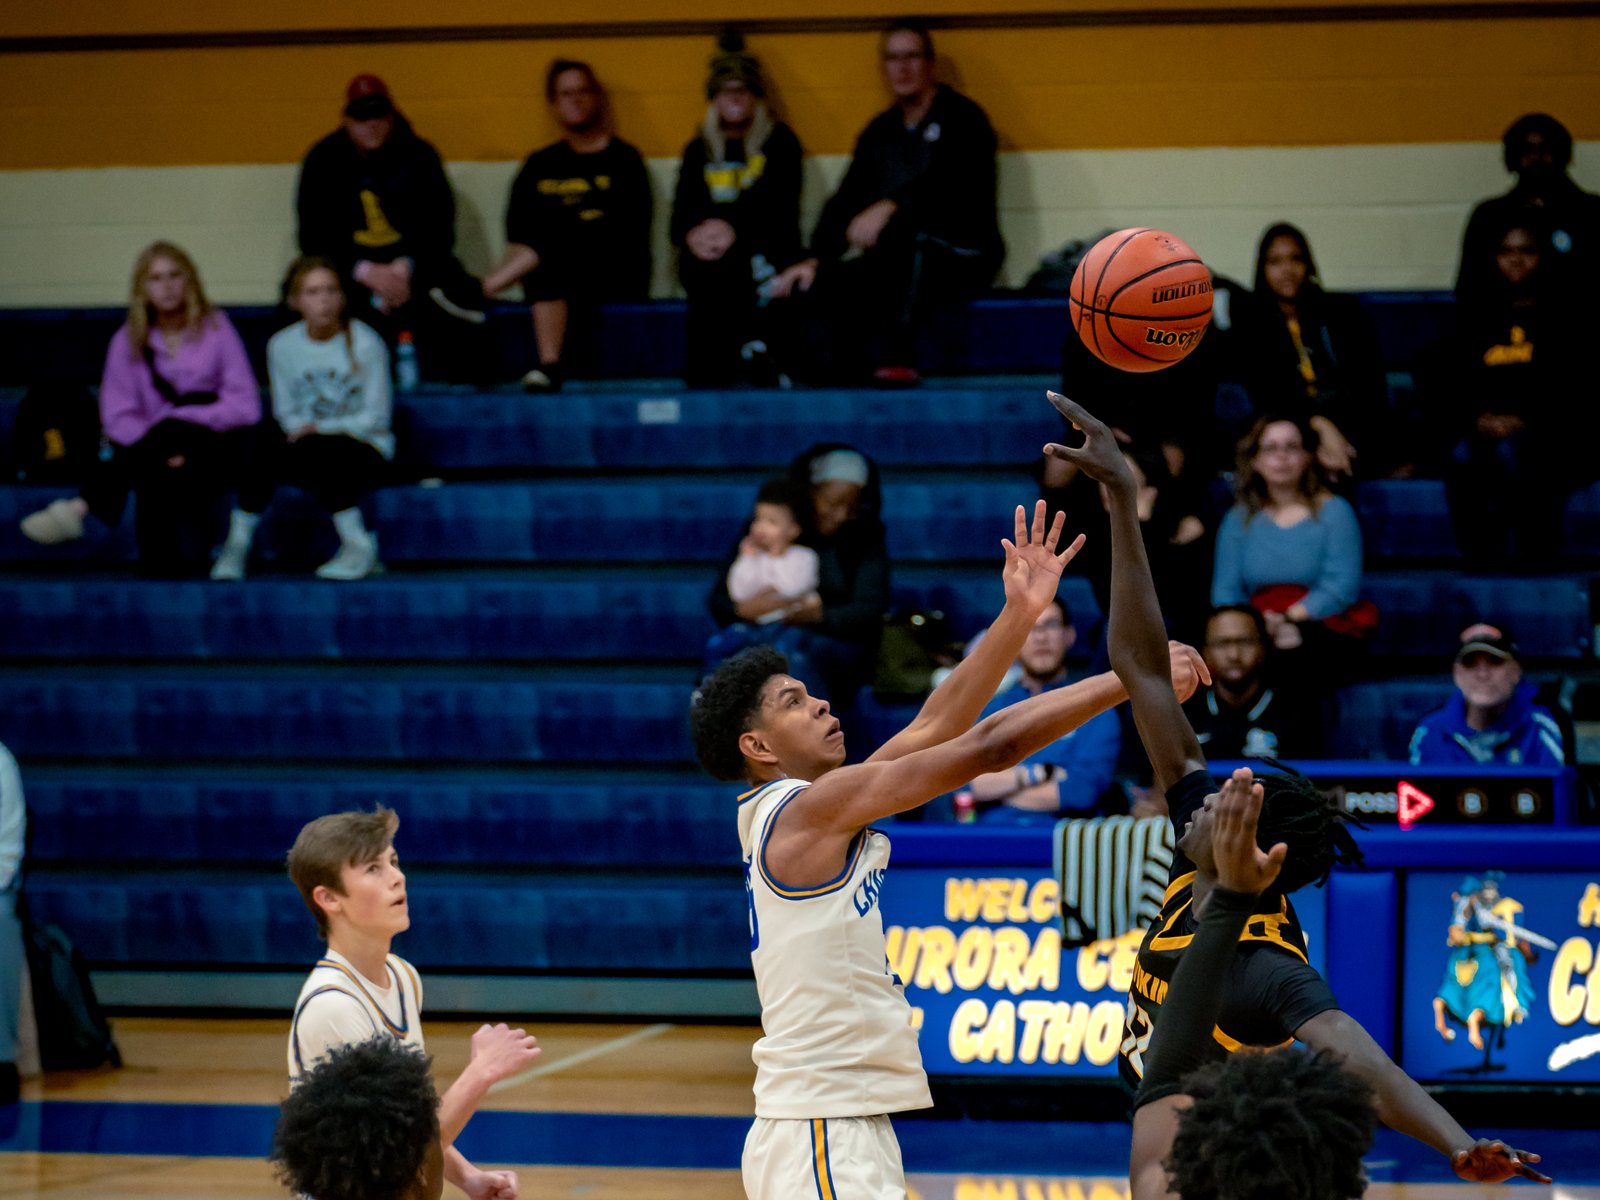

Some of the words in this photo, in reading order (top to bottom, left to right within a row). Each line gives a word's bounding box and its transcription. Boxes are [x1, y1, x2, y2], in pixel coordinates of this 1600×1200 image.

[1344, 792, 1399, 814] POSS
[944, 877, 1061, 923] WELC
[886, 925, 1062, 994] URORA
[1076, 927, 1148, 992] CE
[949, 998, 1126, 1066] CATHO
